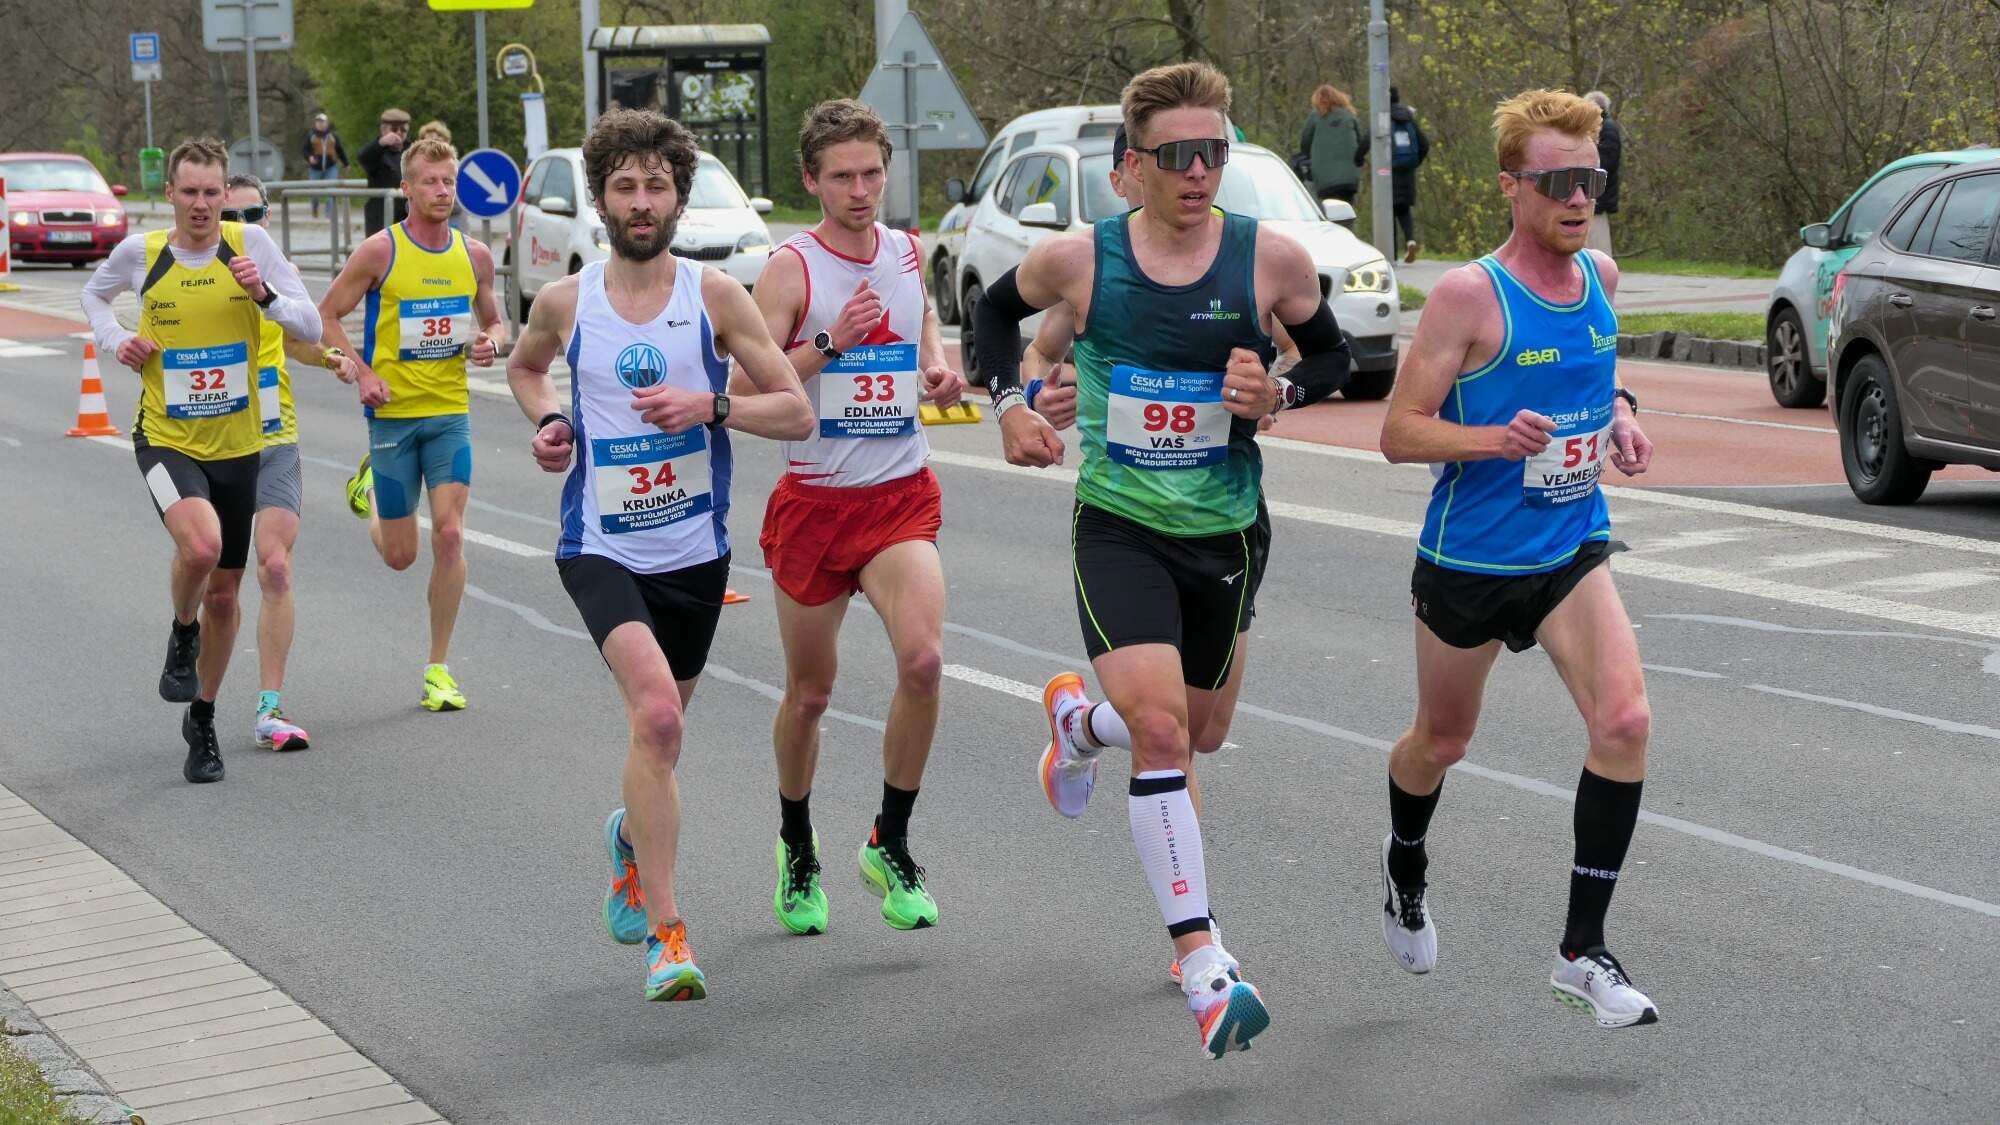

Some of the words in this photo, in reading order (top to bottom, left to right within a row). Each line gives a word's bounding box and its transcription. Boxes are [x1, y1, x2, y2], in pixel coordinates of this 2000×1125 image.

[181, 278, 215, 287] FEJFAR
[422, 317, 452, 337] 38
[420, 338, 452, 348] CHOUR
[176, 352, 199, 360] ČESKÁ
[1516, 348, 1560, 366] eleven
[190, 369, 226, 390] 32
[853, 374, 895, 402] 33
[1130, 373, 1163, 388] ČESKÁ
[188, 392, 228, 402] FEJFAR
[844, 406, 902, 418] EDLMAN
[1143, 403, 1196, 434] 98
[610, 442, 640, 454] ČESKÁ
[1150, 435, 1185, 448] VAŠ
[1562, 433, 1598, 468] 51
[1126, 448, 1142, 457] MČR
[1150, 452, 1208, 460] PŮLMARATONU
[1135, 458, 1178, 466] PARDUBICE
[628, 462, 676, 494] 34
[623, 488, 687, 512] KRUNKA
[619, 514, 634, 523] MČR
[636, 512, 642, 520] V
[643, 500, 694, 520] PŮLMARATONU
[630, 516, 670, 528] PARDUBICE
[670, 510, 686, 520] 2023
[1161, 800, 1180, 876] COMPRESSPORT
